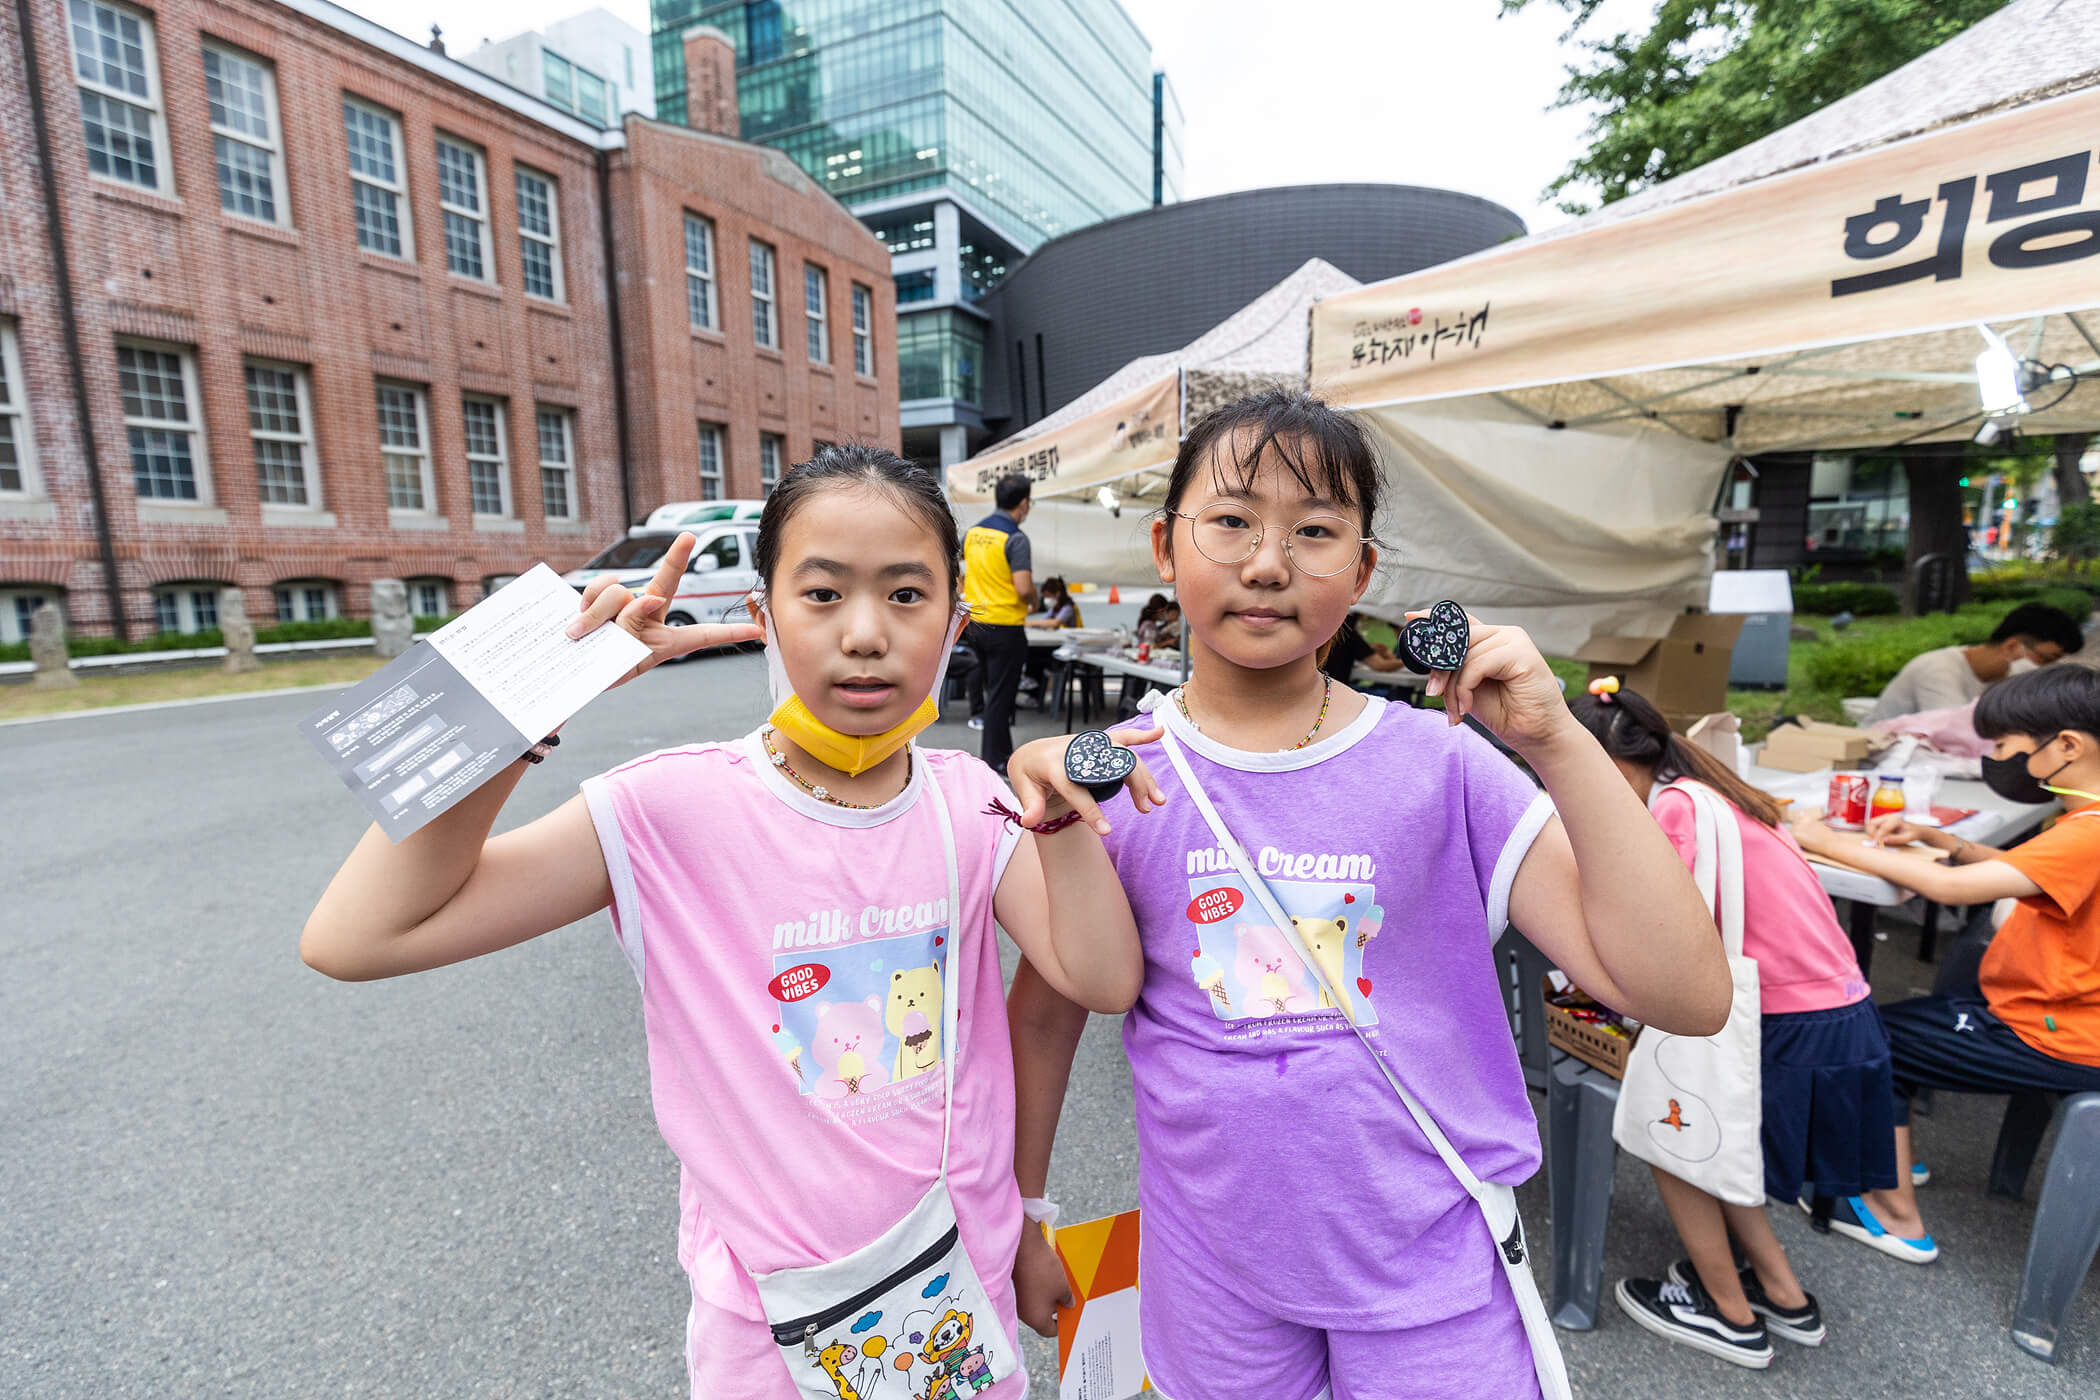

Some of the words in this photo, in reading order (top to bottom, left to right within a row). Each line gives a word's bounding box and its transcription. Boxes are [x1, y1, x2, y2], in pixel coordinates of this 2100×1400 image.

[1187, 841, 1238, 875] mi
[1258, 846, 1376, 880] Cream
[1198, 891, 1228, 911] GOOD
[1200, 902, 1234, 922] VIBES
[773, 909, 853, 950] milk
[780, 967, 814, 989] GOOD
[781, 979, 819, 1001] VIBES
